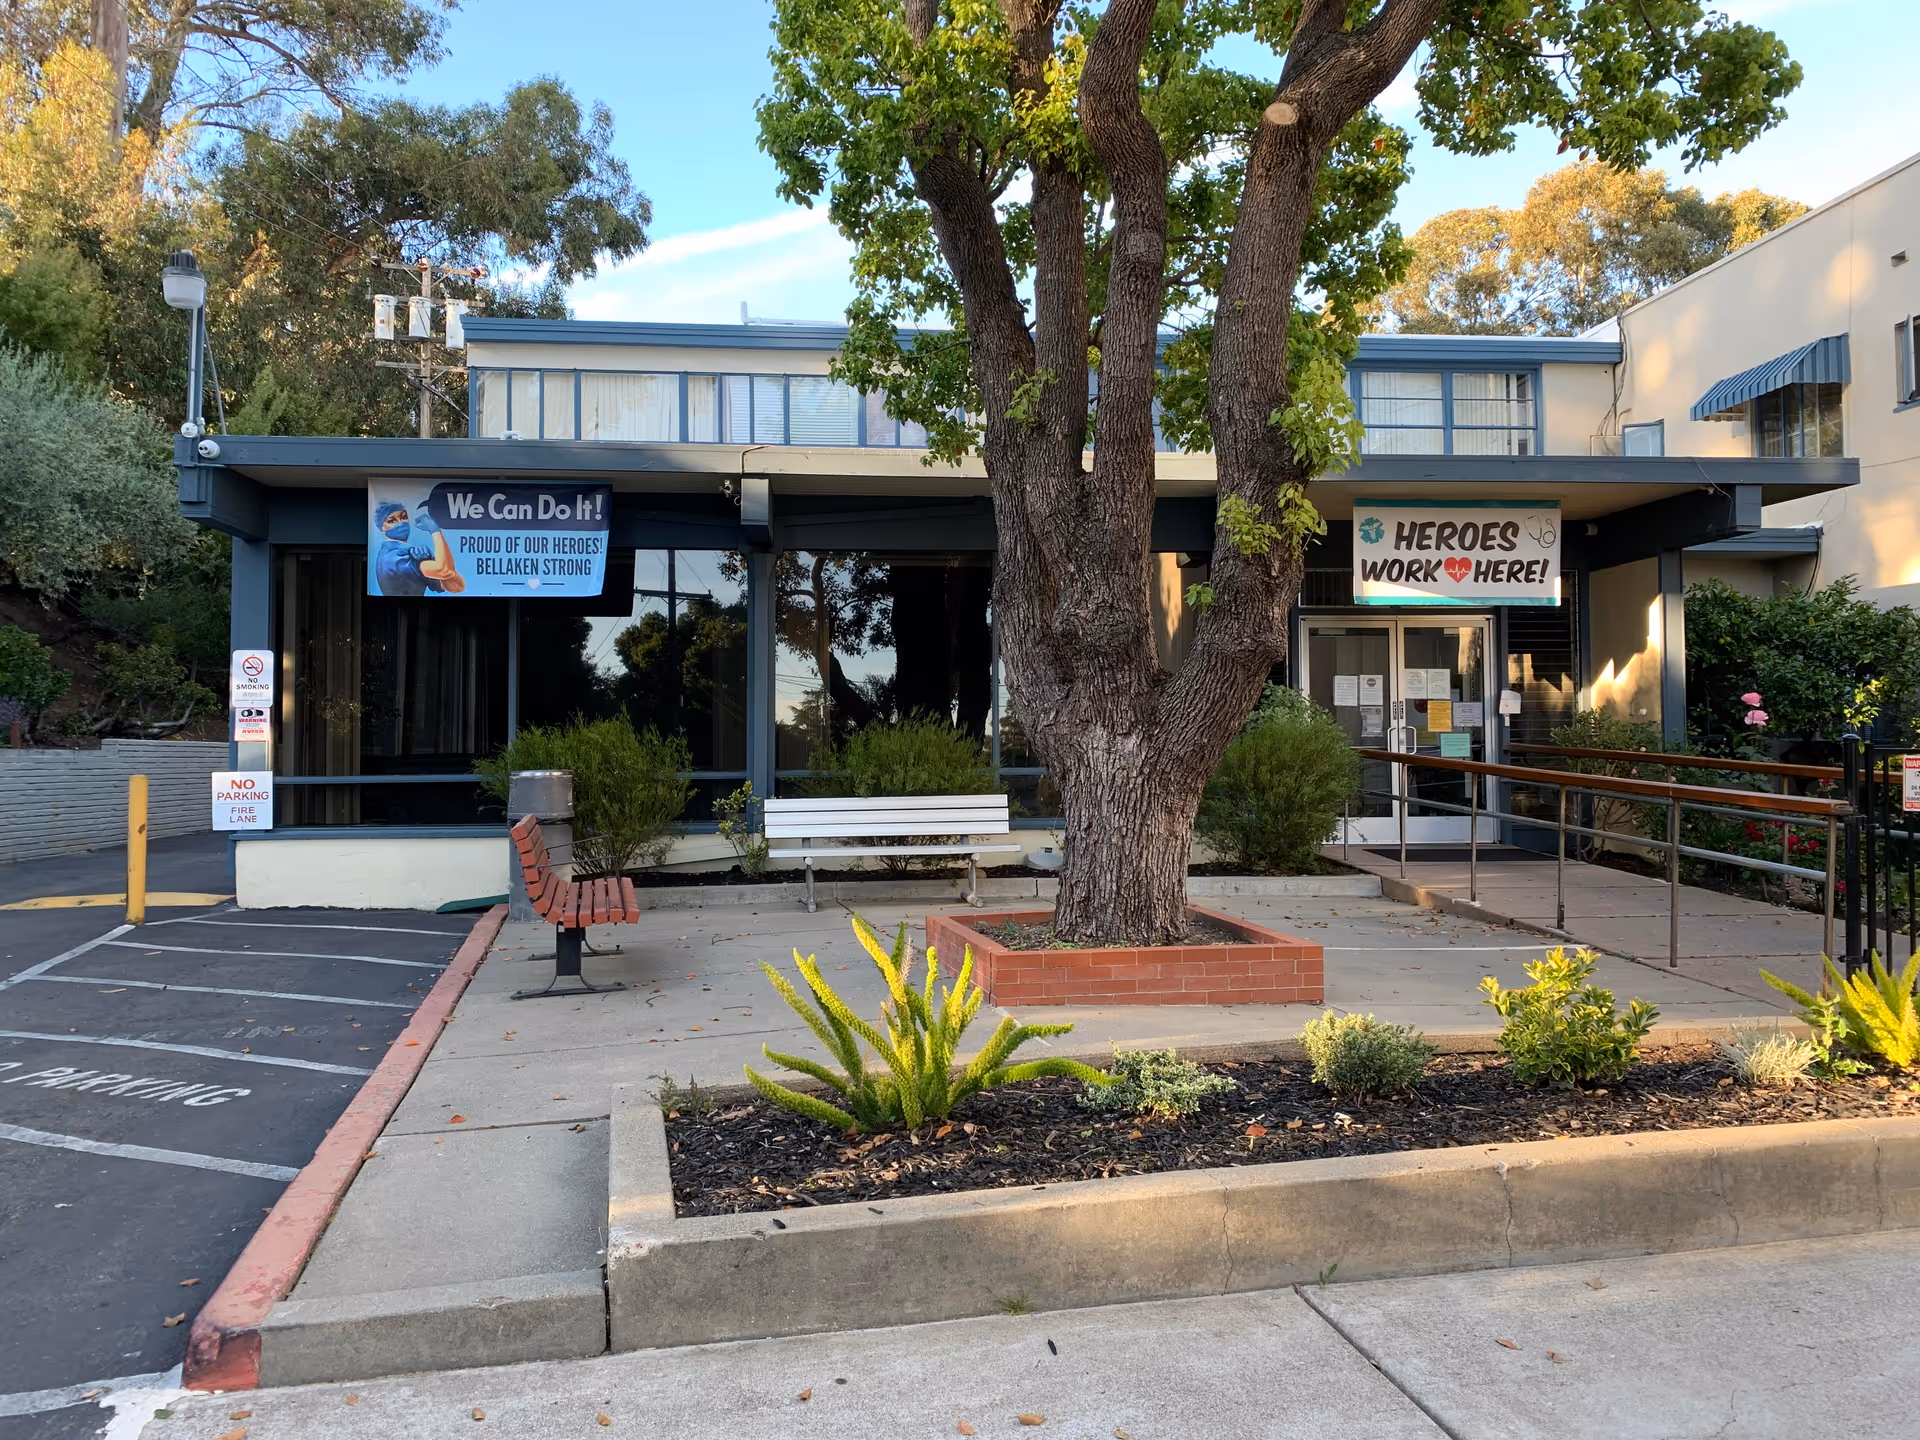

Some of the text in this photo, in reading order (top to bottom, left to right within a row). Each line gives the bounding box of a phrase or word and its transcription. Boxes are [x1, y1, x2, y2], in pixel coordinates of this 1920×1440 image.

[447, 492, 603, 520] We Can Do It!
[460, 536, 603, 554] PROUD OF OUR HEROES!
[1394, 521, 1520, 551] HEROES
[476, 557, 592, 575] BELLAKEN STRONG
[1361, 558, 1550, 584] WORK HERE!
[230, 779, 256, 789] NO
[216, 791, 269, 801] PARKING
[229, 815, 257, 823] LANE
[231, 806, 255, 814] FIRE
[1, 1067, 252, 1106] PARKING
